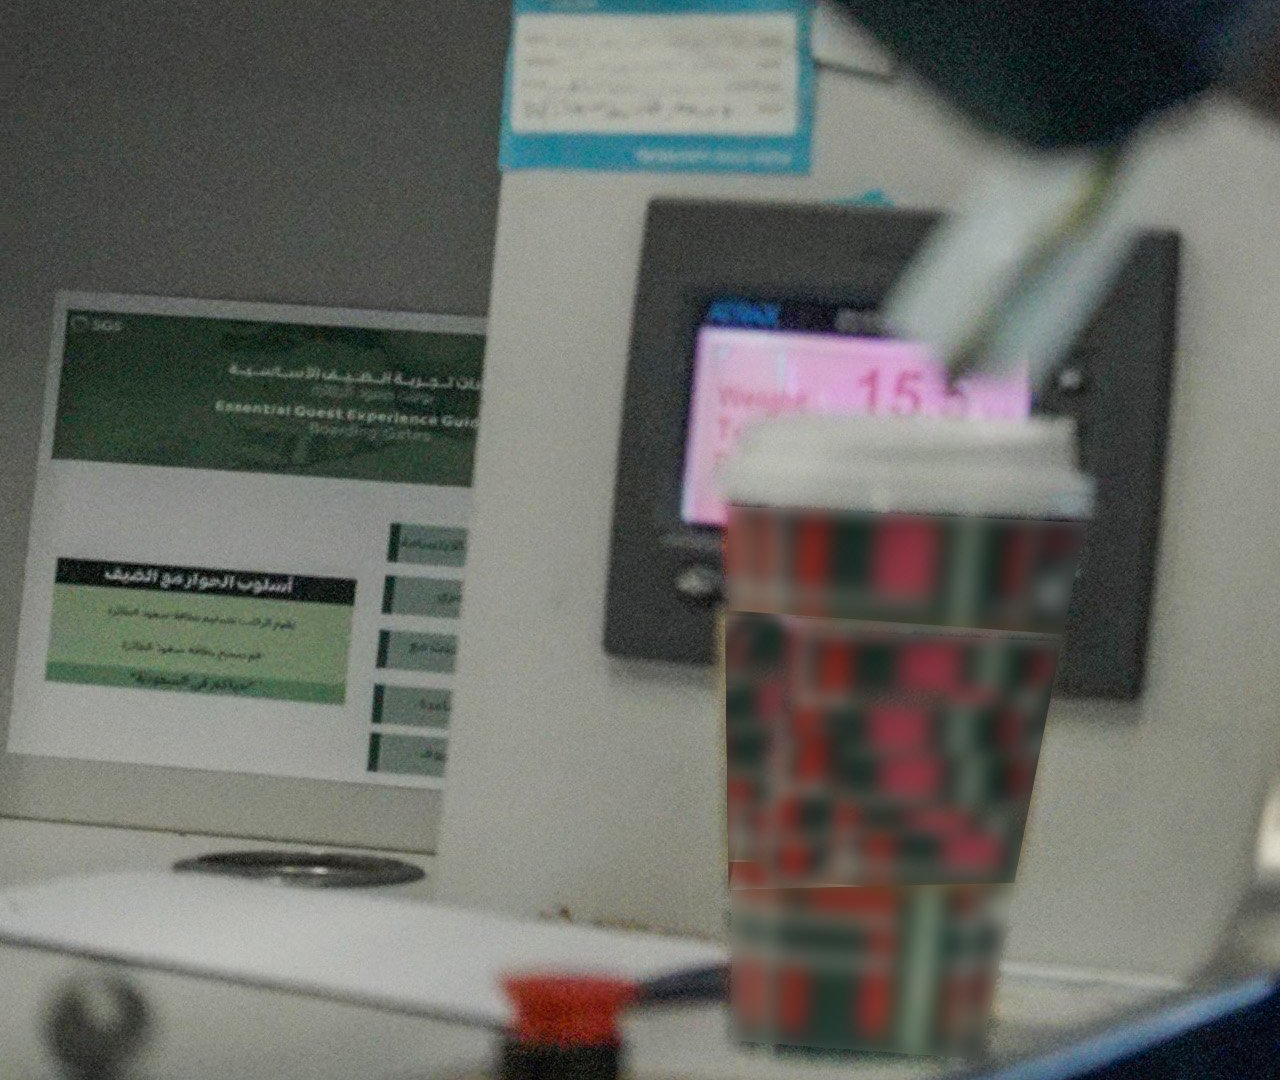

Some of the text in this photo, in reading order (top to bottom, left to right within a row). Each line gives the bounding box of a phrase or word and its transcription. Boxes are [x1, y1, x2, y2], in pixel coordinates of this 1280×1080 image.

[215, 400, 292, 416] Essential
[294, 405, 344, 421] Guest
[346, 409, 439, 427] Experience
[104, 566, 295, 594] أسلوب الحوار مع الضيف
